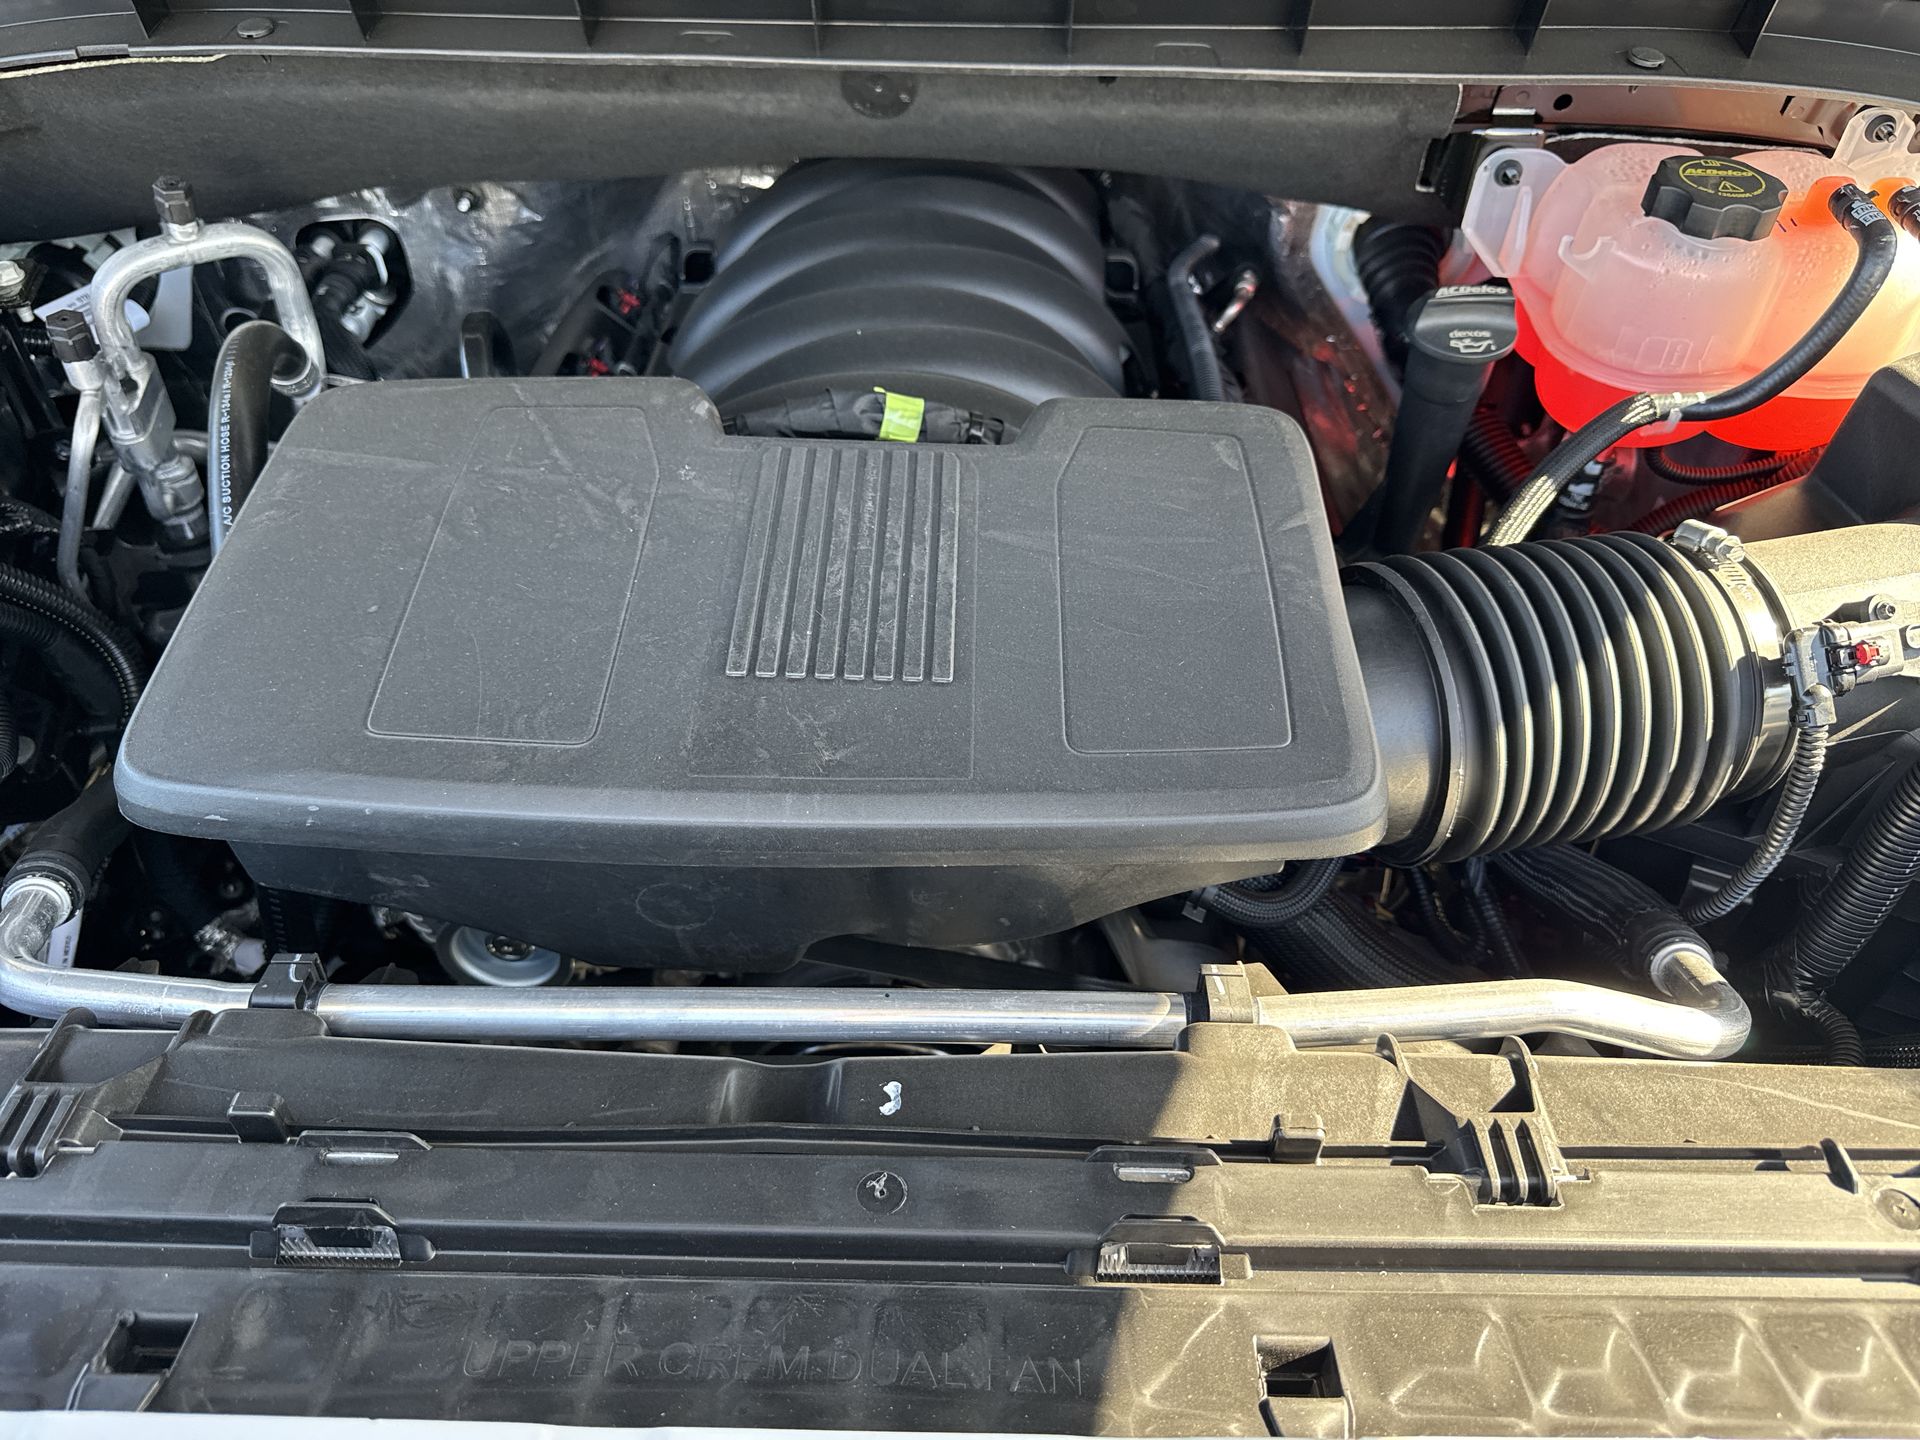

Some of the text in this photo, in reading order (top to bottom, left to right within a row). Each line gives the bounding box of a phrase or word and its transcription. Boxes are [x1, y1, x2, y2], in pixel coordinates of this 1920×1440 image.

[1683, 168, 1754, 177] ACDelco
[1435, 285, 1508, 298] ACDelco
[1449, 329, 1491, 338] dexos
[220, 424, 231, 453] HOSE
[220, 455, 232, 504] SUCTION
[222, 505, 233, 526] A/C
[463, 1339, 643, 1377] UPPER
[829, 1347, 967, 1388] DUAL
